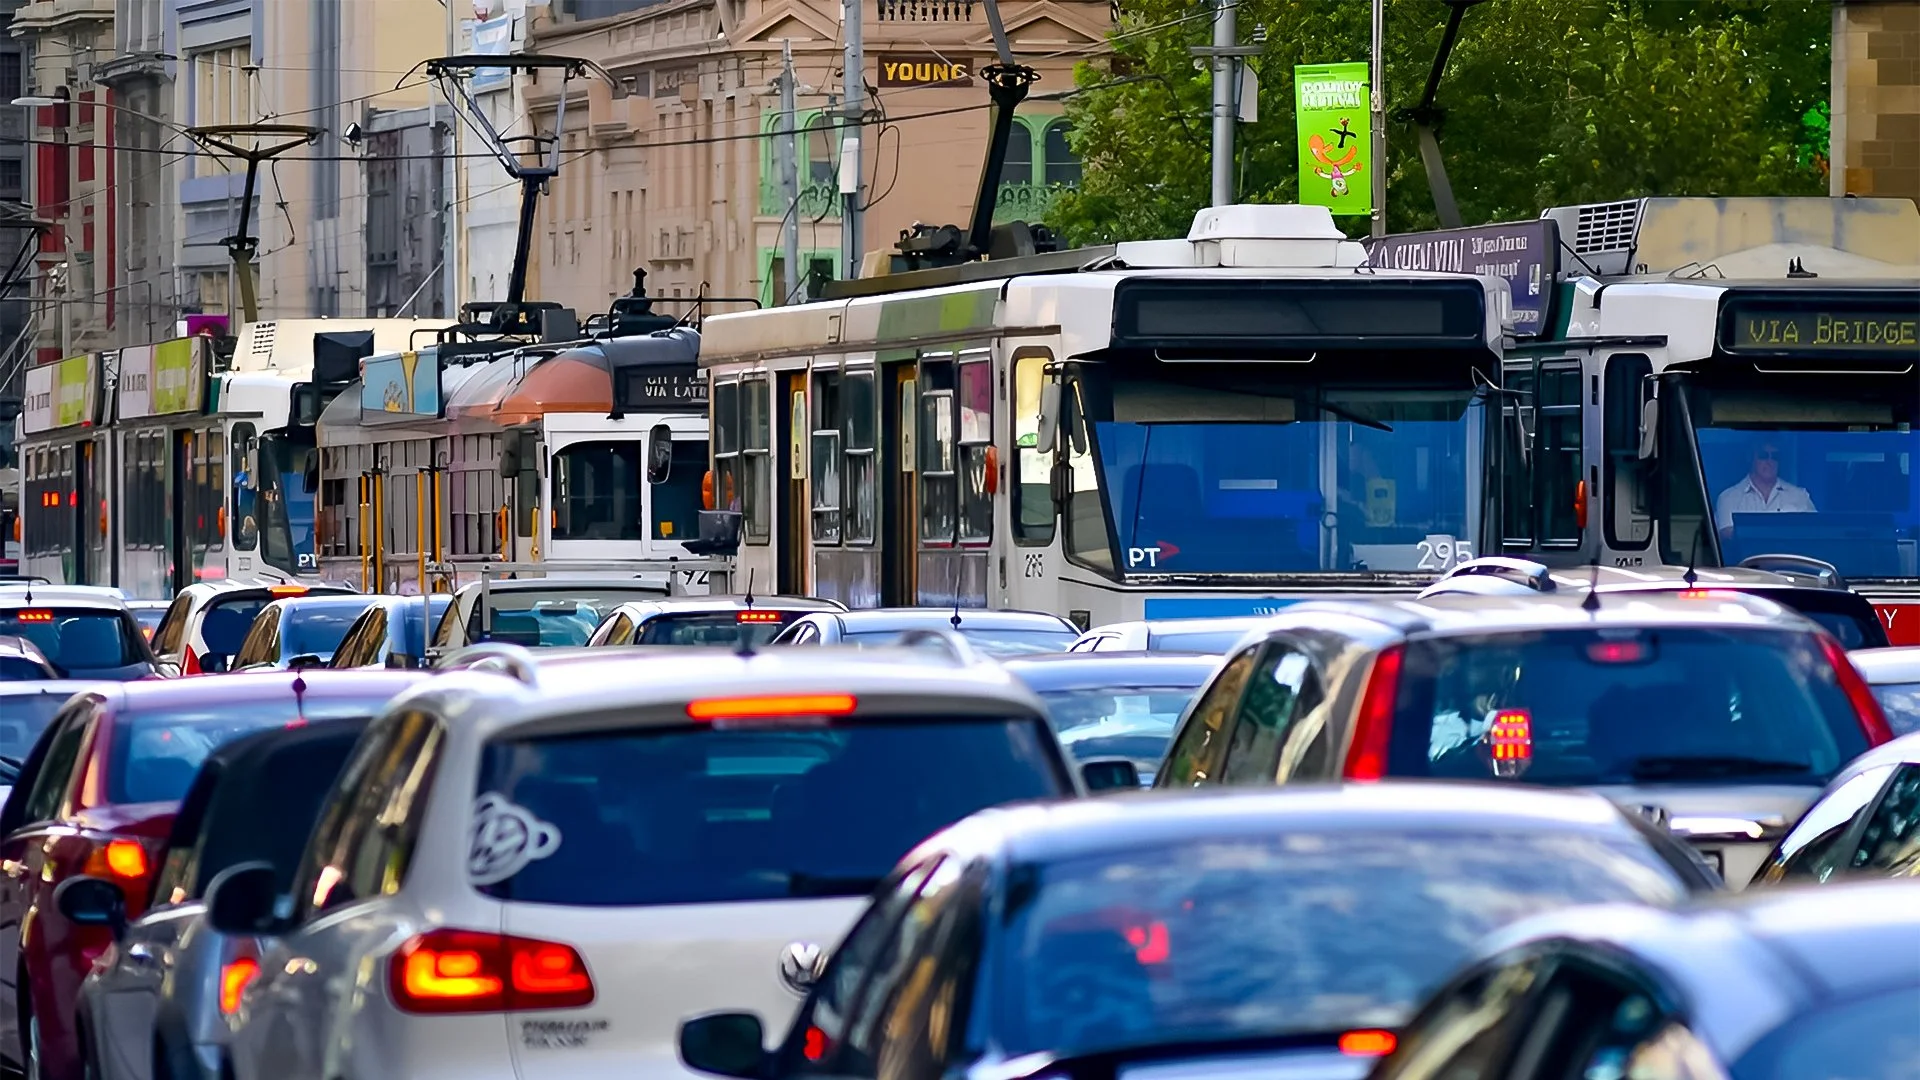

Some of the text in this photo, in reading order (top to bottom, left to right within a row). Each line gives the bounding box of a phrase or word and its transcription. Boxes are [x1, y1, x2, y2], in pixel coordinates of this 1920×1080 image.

[1749, 312, 1917, 345] VIA BRIDGE
[645, 385, 667, 397] VIA
[1128, 546, 1161, 568] PT
[1416, 540, 1474, 568] 295
